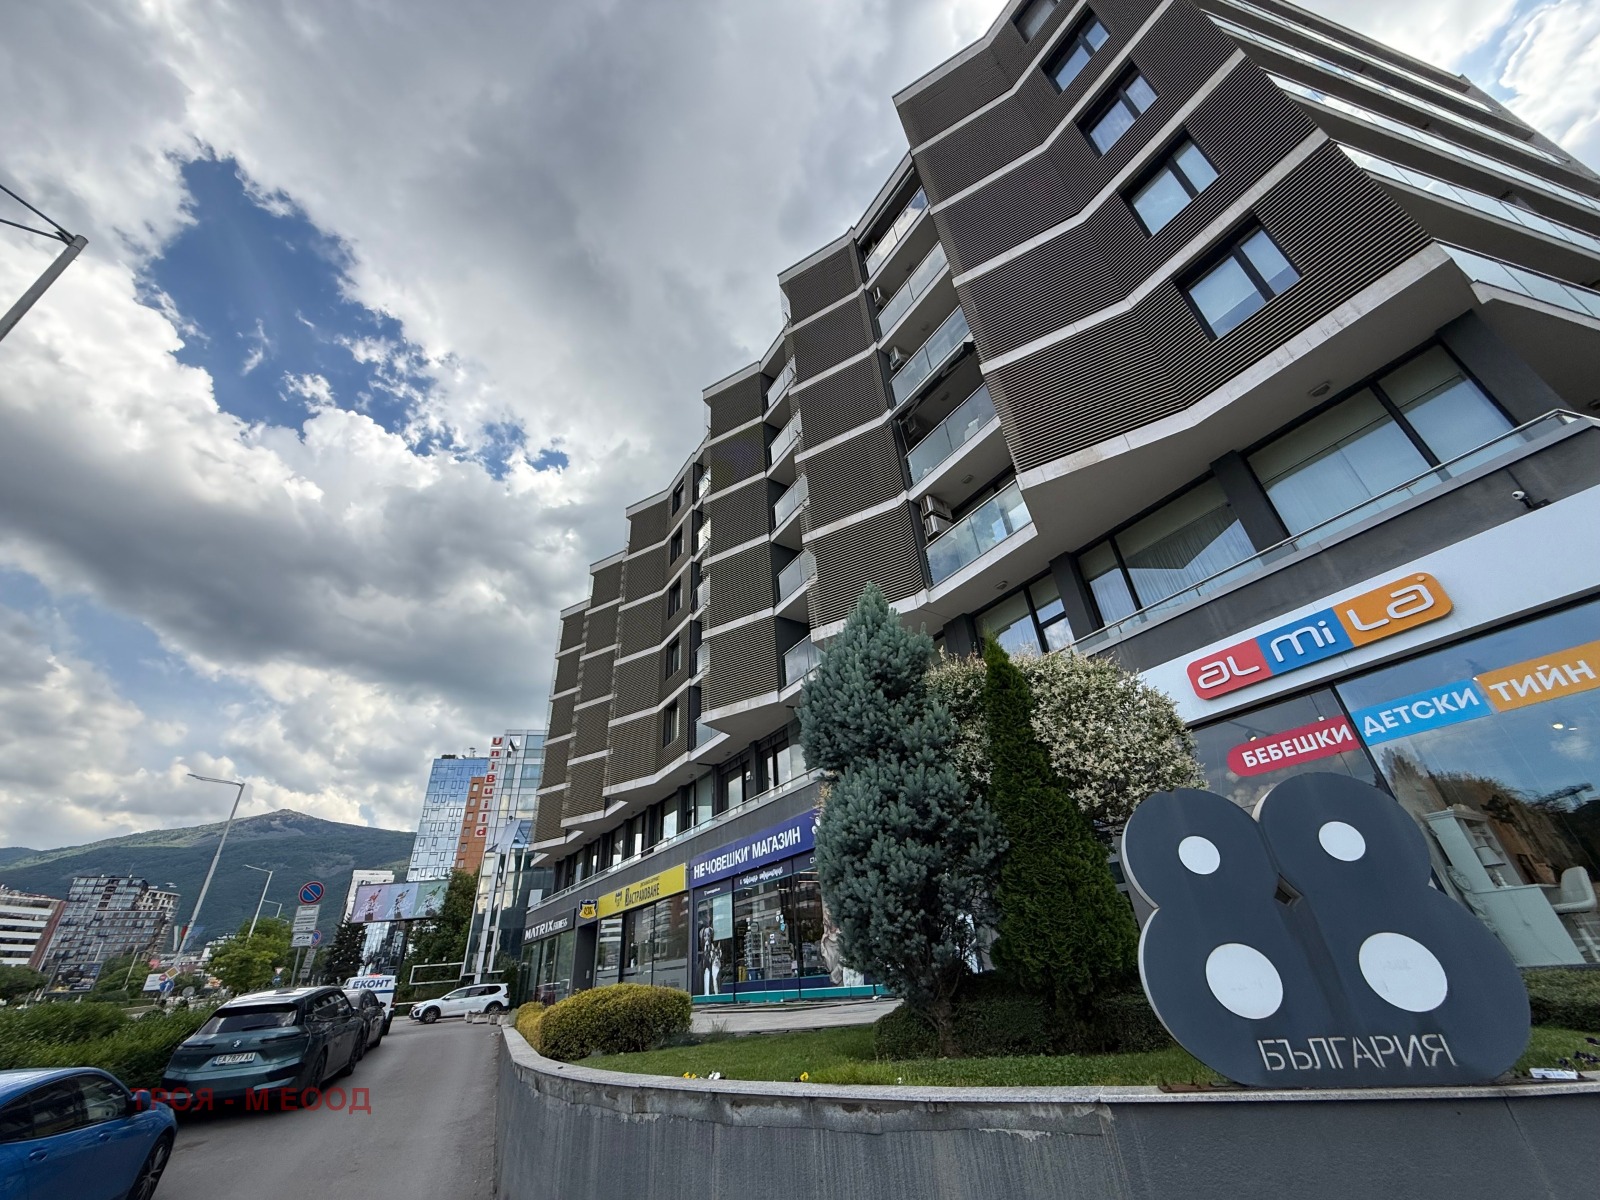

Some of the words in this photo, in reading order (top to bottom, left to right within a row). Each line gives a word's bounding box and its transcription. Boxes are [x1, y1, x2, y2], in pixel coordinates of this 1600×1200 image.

[1241, 723, 1354, 769] БЕБЕШКИ
[1363, 686, 1480, 738] ДЕТСКИ
[1489, 659, 1597, 703] ТИЙН
[751, 826, 801, 860] МАГАЗИН
[524, 919, 554, 941] MATRIX
[352, 979, 392, 990] ЕКОНТ
[1257, 1033, 1458, 1071] БЪЛГАРИЯ
